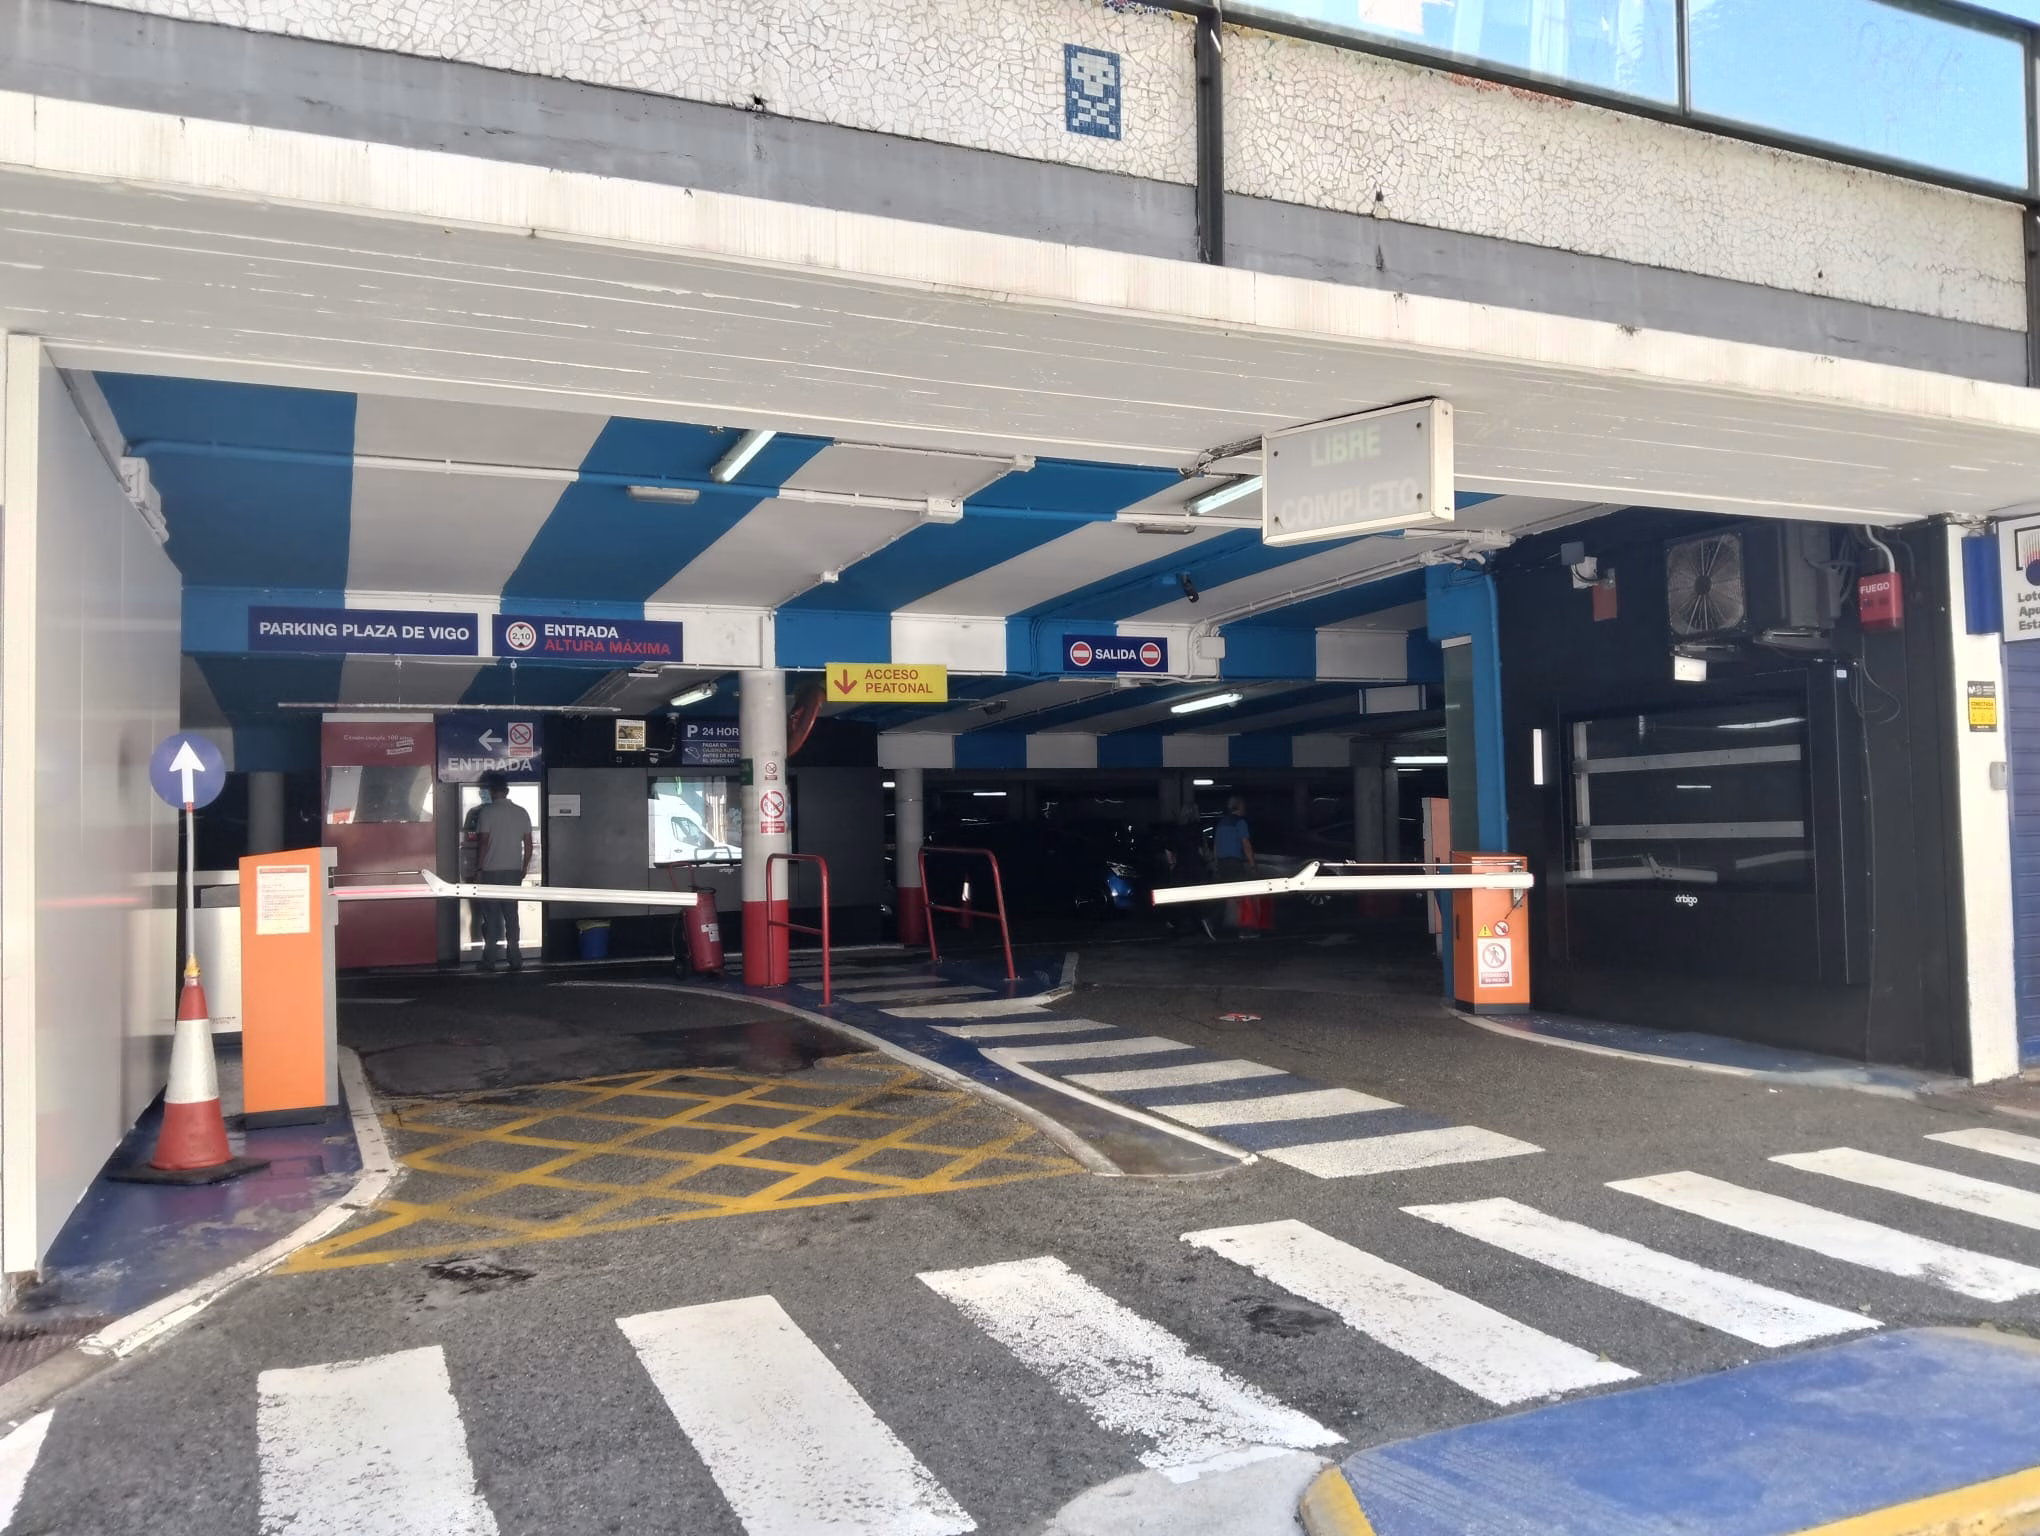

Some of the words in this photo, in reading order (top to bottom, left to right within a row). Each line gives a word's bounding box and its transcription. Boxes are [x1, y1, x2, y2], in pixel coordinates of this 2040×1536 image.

[1311, 424, 1381, 467] LIBRE
[1280, 478, 1418, 528] COMPLETO
[1859, 582, 1890, 595] FUEGO
[259, 621, 338, 637] PARKING
[342, 624, 397, 638] PLAZA
[402, 626, 425, 639] DE
[429, 627, 470, 641] VIGO
[512, 632, 531, 641] 2,10
[544, 623, 619, 639] ENTRADA
[544, 639, 604, 652] ALTURA
[609, 639, 671, 655] MÁXIMA
[1095, 648, 1137, 660] SALIDA
[864, 669, 919, 680] ACCESO
[865, 682, 933, 694] PEATONAL
[687, 724, 699, 738] P
[702, 727, 714, 736] 24
[447, 757, 533, 771] ENTRADA
